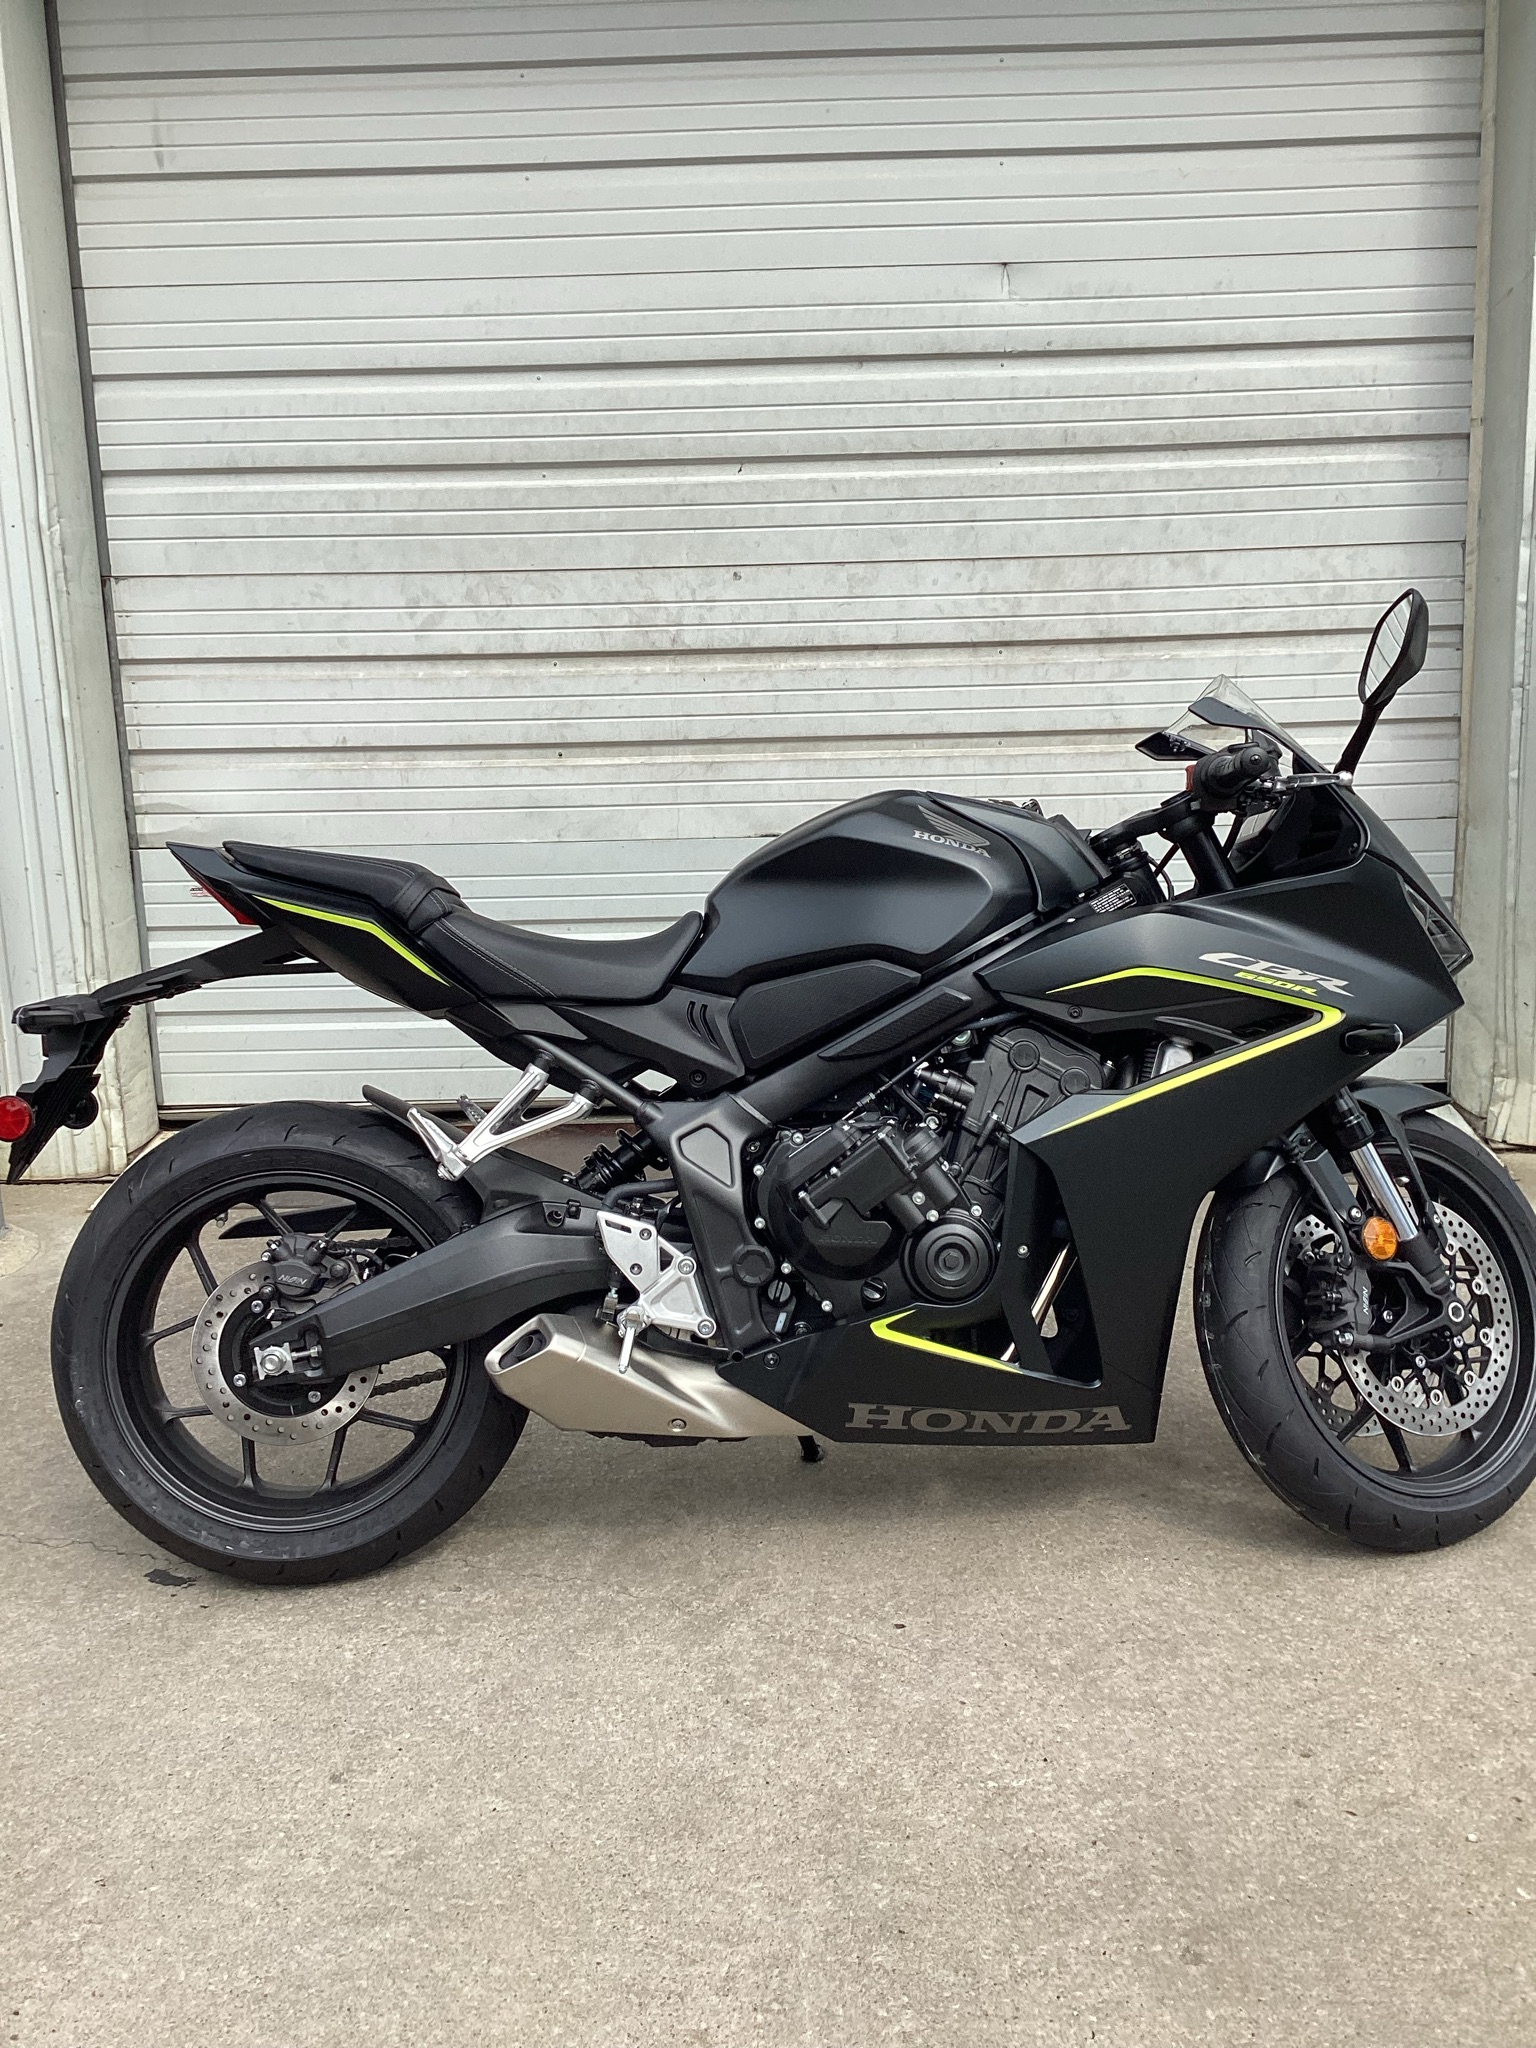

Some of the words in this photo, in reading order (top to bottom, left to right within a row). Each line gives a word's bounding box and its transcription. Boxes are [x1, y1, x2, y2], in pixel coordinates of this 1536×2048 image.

[912, 829, 991, 859] HONDA
[1199, 952, 1355, 997] CBR
[1234, 971, 1318, 997] 650R
[845, 1402, 1132, 1434] HONDA
